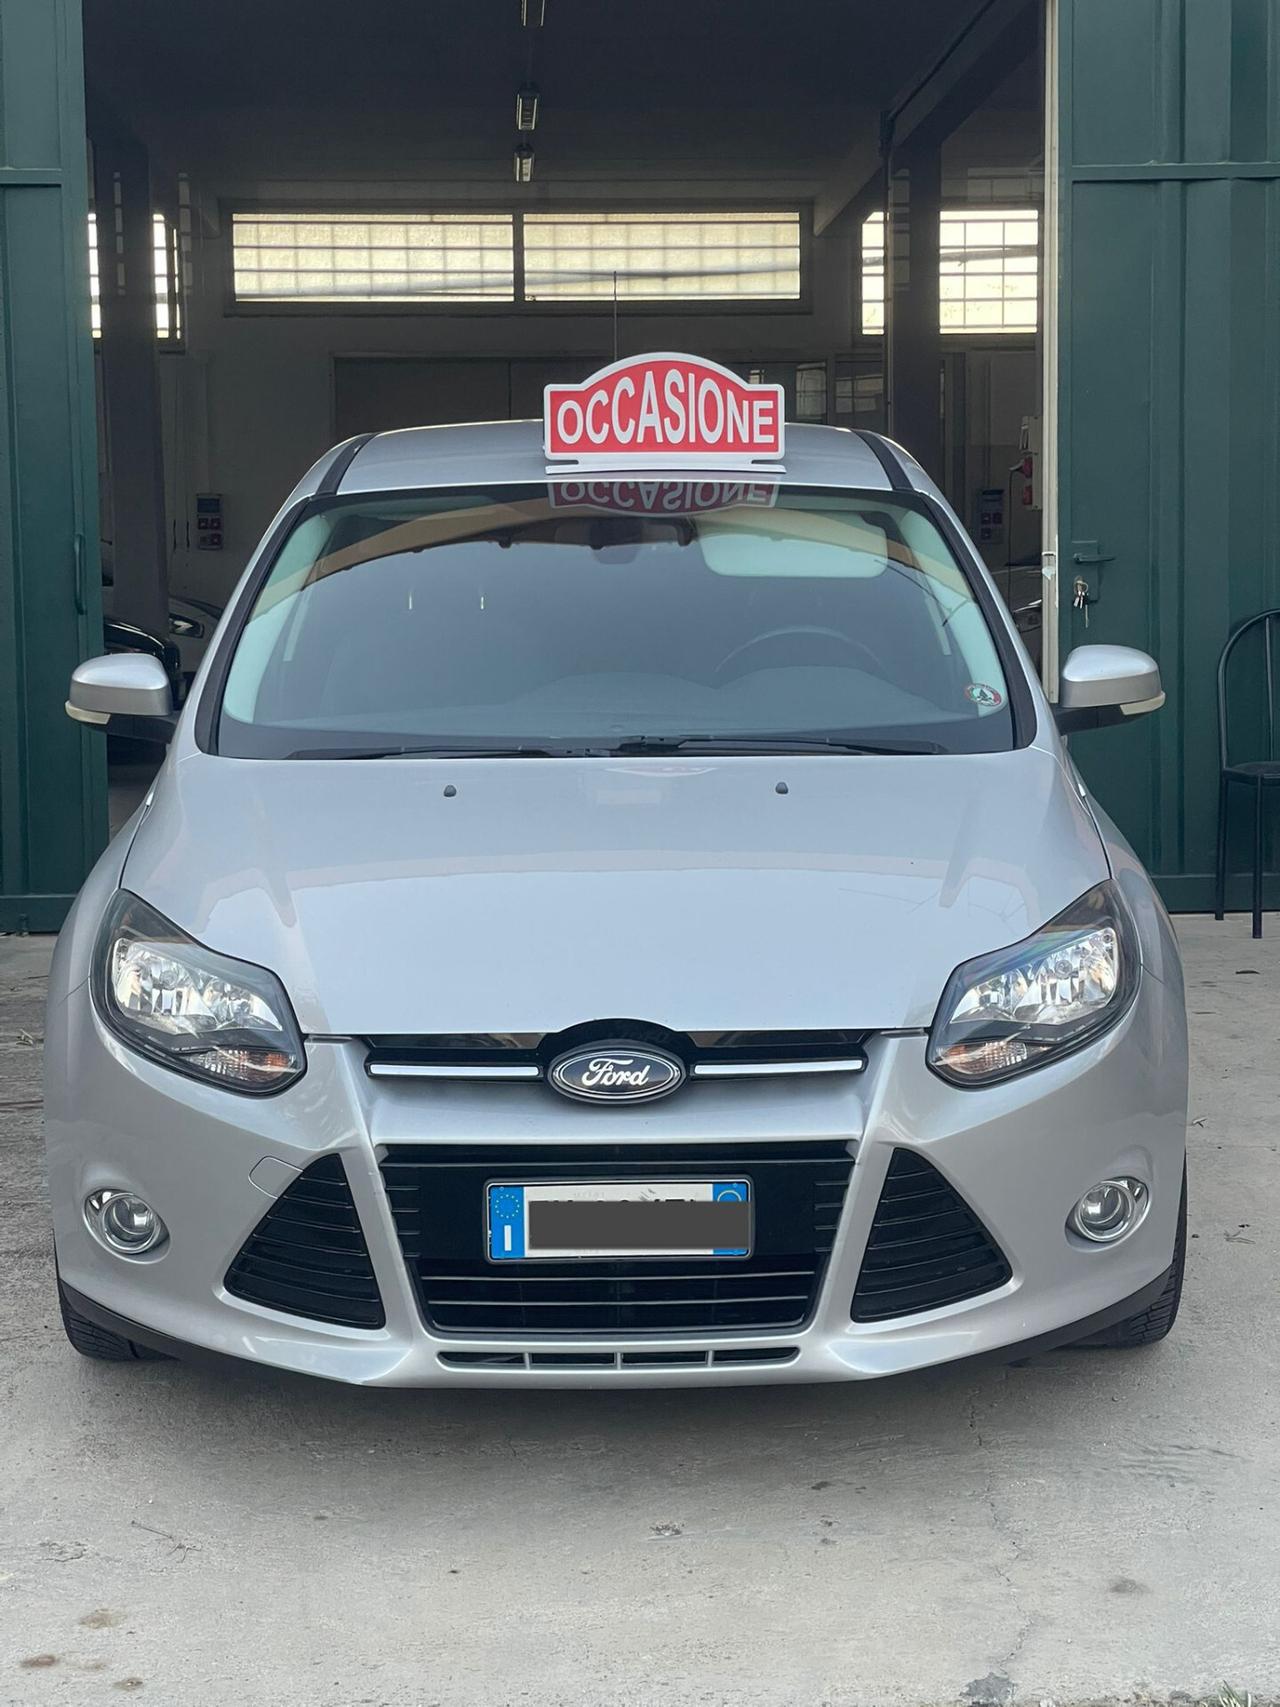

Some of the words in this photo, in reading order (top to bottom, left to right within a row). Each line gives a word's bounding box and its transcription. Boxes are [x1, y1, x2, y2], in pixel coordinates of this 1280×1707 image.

[557, 368, 775, 444] OCCASIONE
[581, 1058, 651, 1086] Ford
[504, 1225, 512, 1251] I
